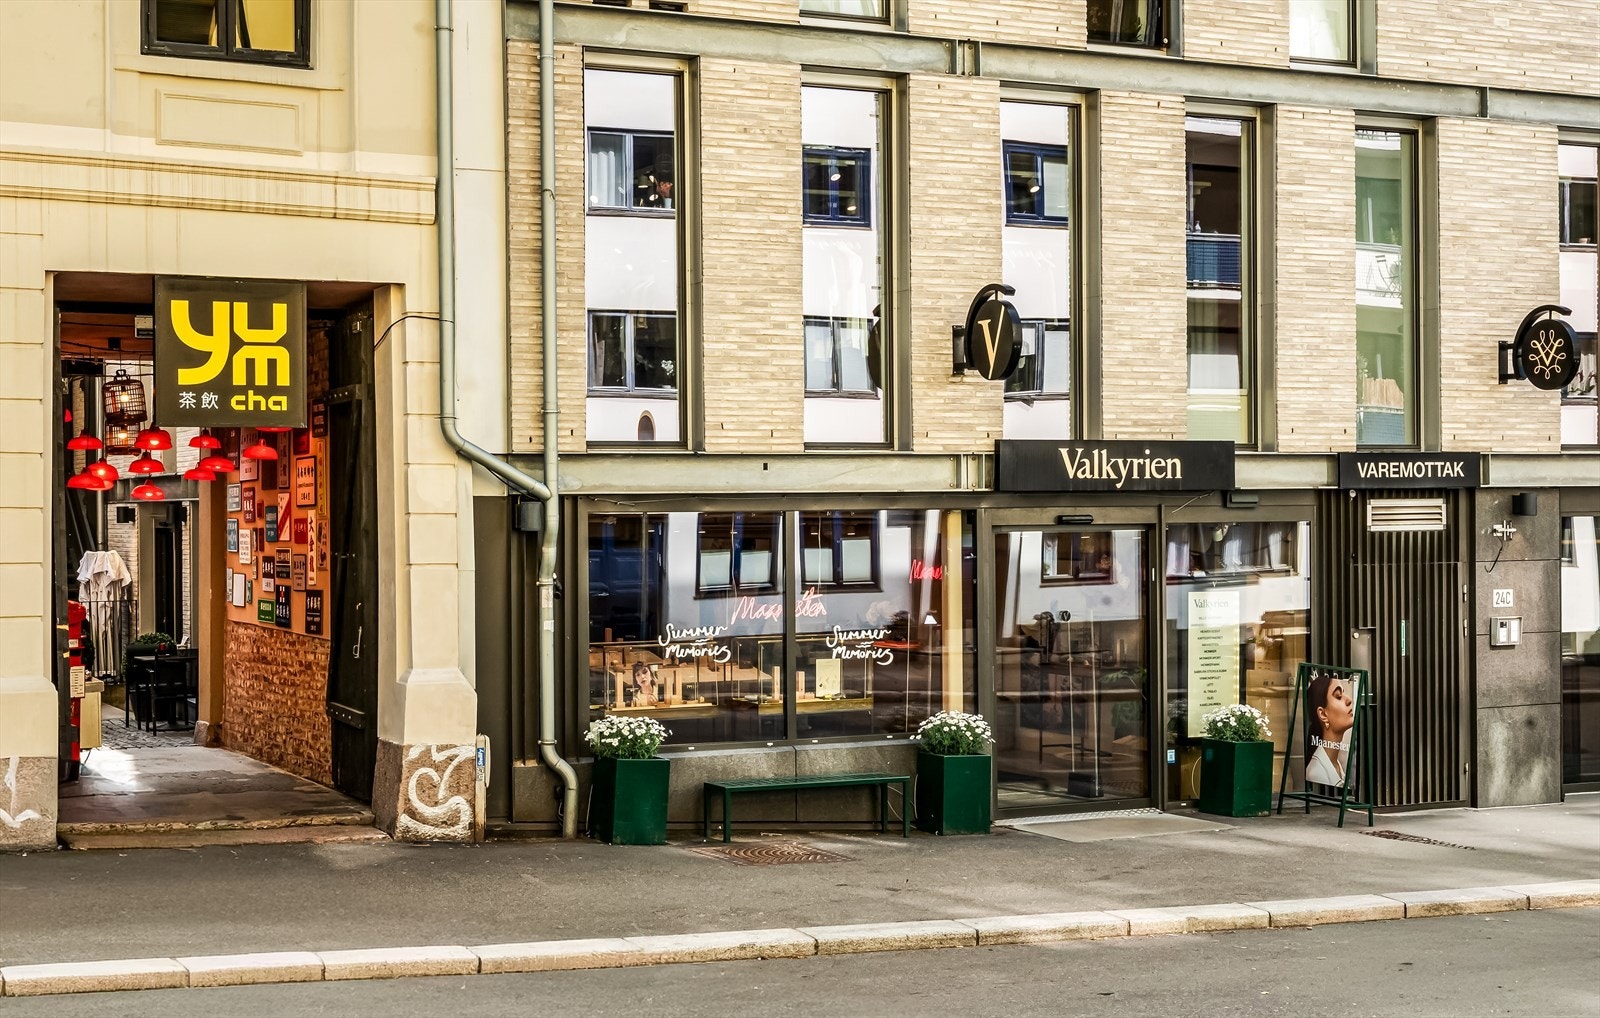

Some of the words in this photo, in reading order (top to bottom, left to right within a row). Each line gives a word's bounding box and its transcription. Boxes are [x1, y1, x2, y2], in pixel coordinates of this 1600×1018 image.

[179, 391, 219, 410] 茶飲
[230, 390, 288, 411] cha
[1058, 447, 1183, 489] Valkyrien
[1357, 461, 1465, 478] VAREMOTTAK
[1495, 591, 1511, 605] 24C
[658, 623, 728, 646] Summer
[826, 625, 891, 648] Summer
[665, 643, 731, 663] Memories
[832, 646, 894, 666] Memories
